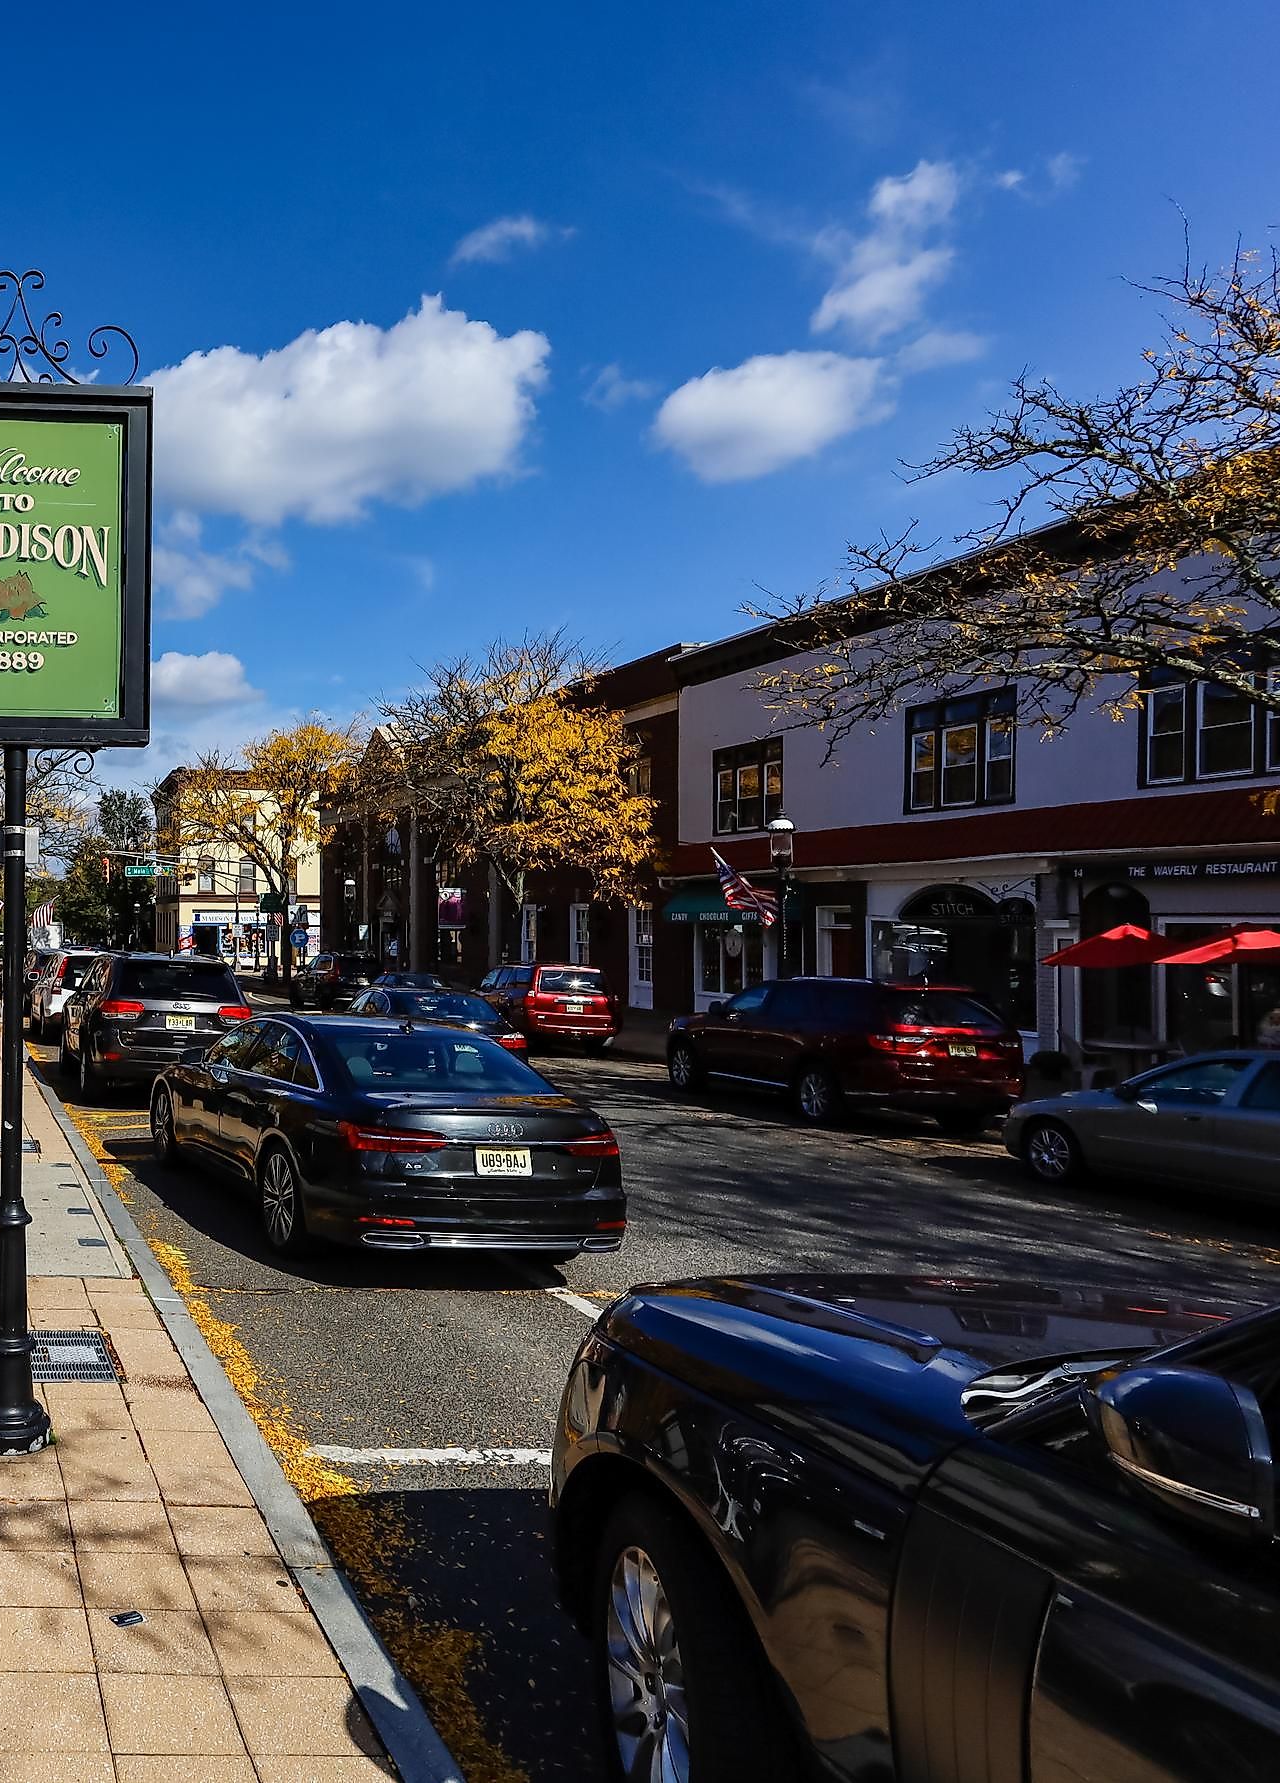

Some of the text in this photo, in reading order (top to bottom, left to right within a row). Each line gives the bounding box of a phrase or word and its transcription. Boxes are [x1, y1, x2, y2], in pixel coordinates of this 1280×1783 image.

[1073, 861, 1279, 878] 14 THE WAVERLY RESTAURANT
[930, 903, 974, 916] STITCH
[201, 915, 231, 923] MADISON
[671, 911, 758, 921] CANDY CHOCOLATE GIFTS
